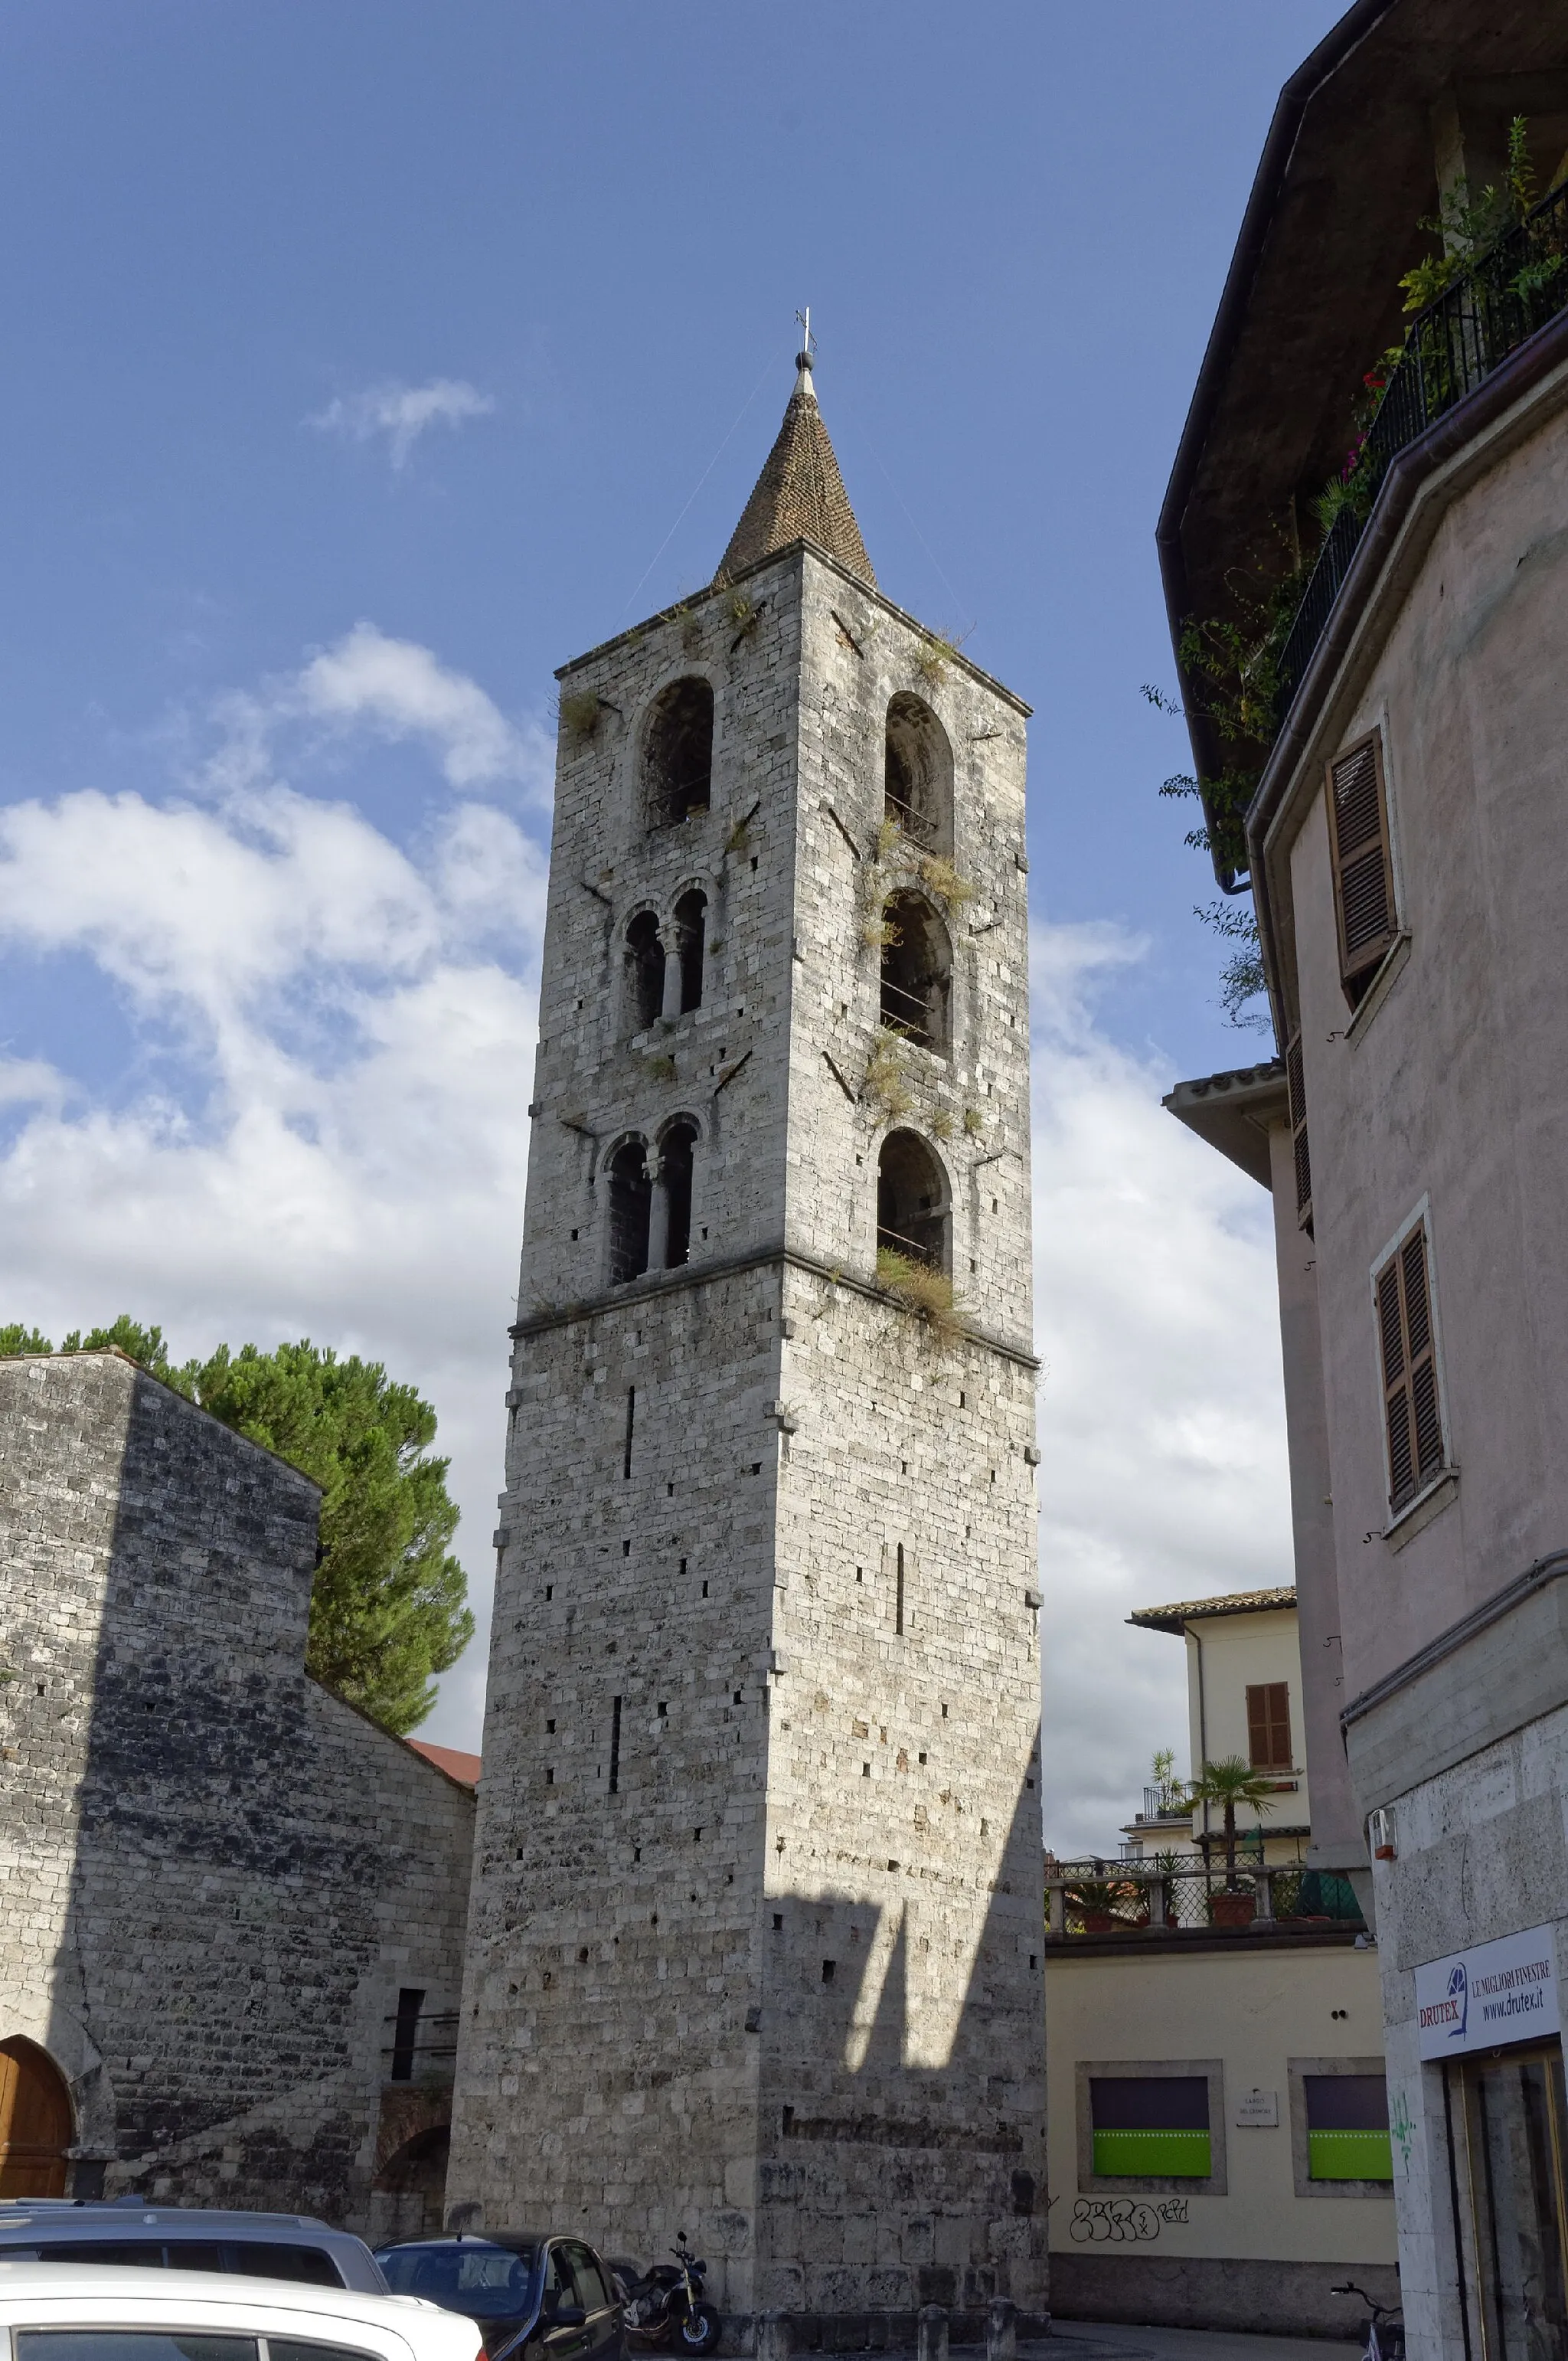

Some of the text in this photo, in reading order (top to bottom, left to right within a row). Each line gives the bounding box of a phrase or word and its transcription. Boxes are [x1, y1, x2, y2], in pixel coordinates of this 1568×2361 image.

[1472, 1960, 1551, 1998] LE MIGLIORI FINESTRE
[1419, 2000, 1459, 2029] DRUTEX
[1482, 1986, 1544, 2022] www.drutex.it
